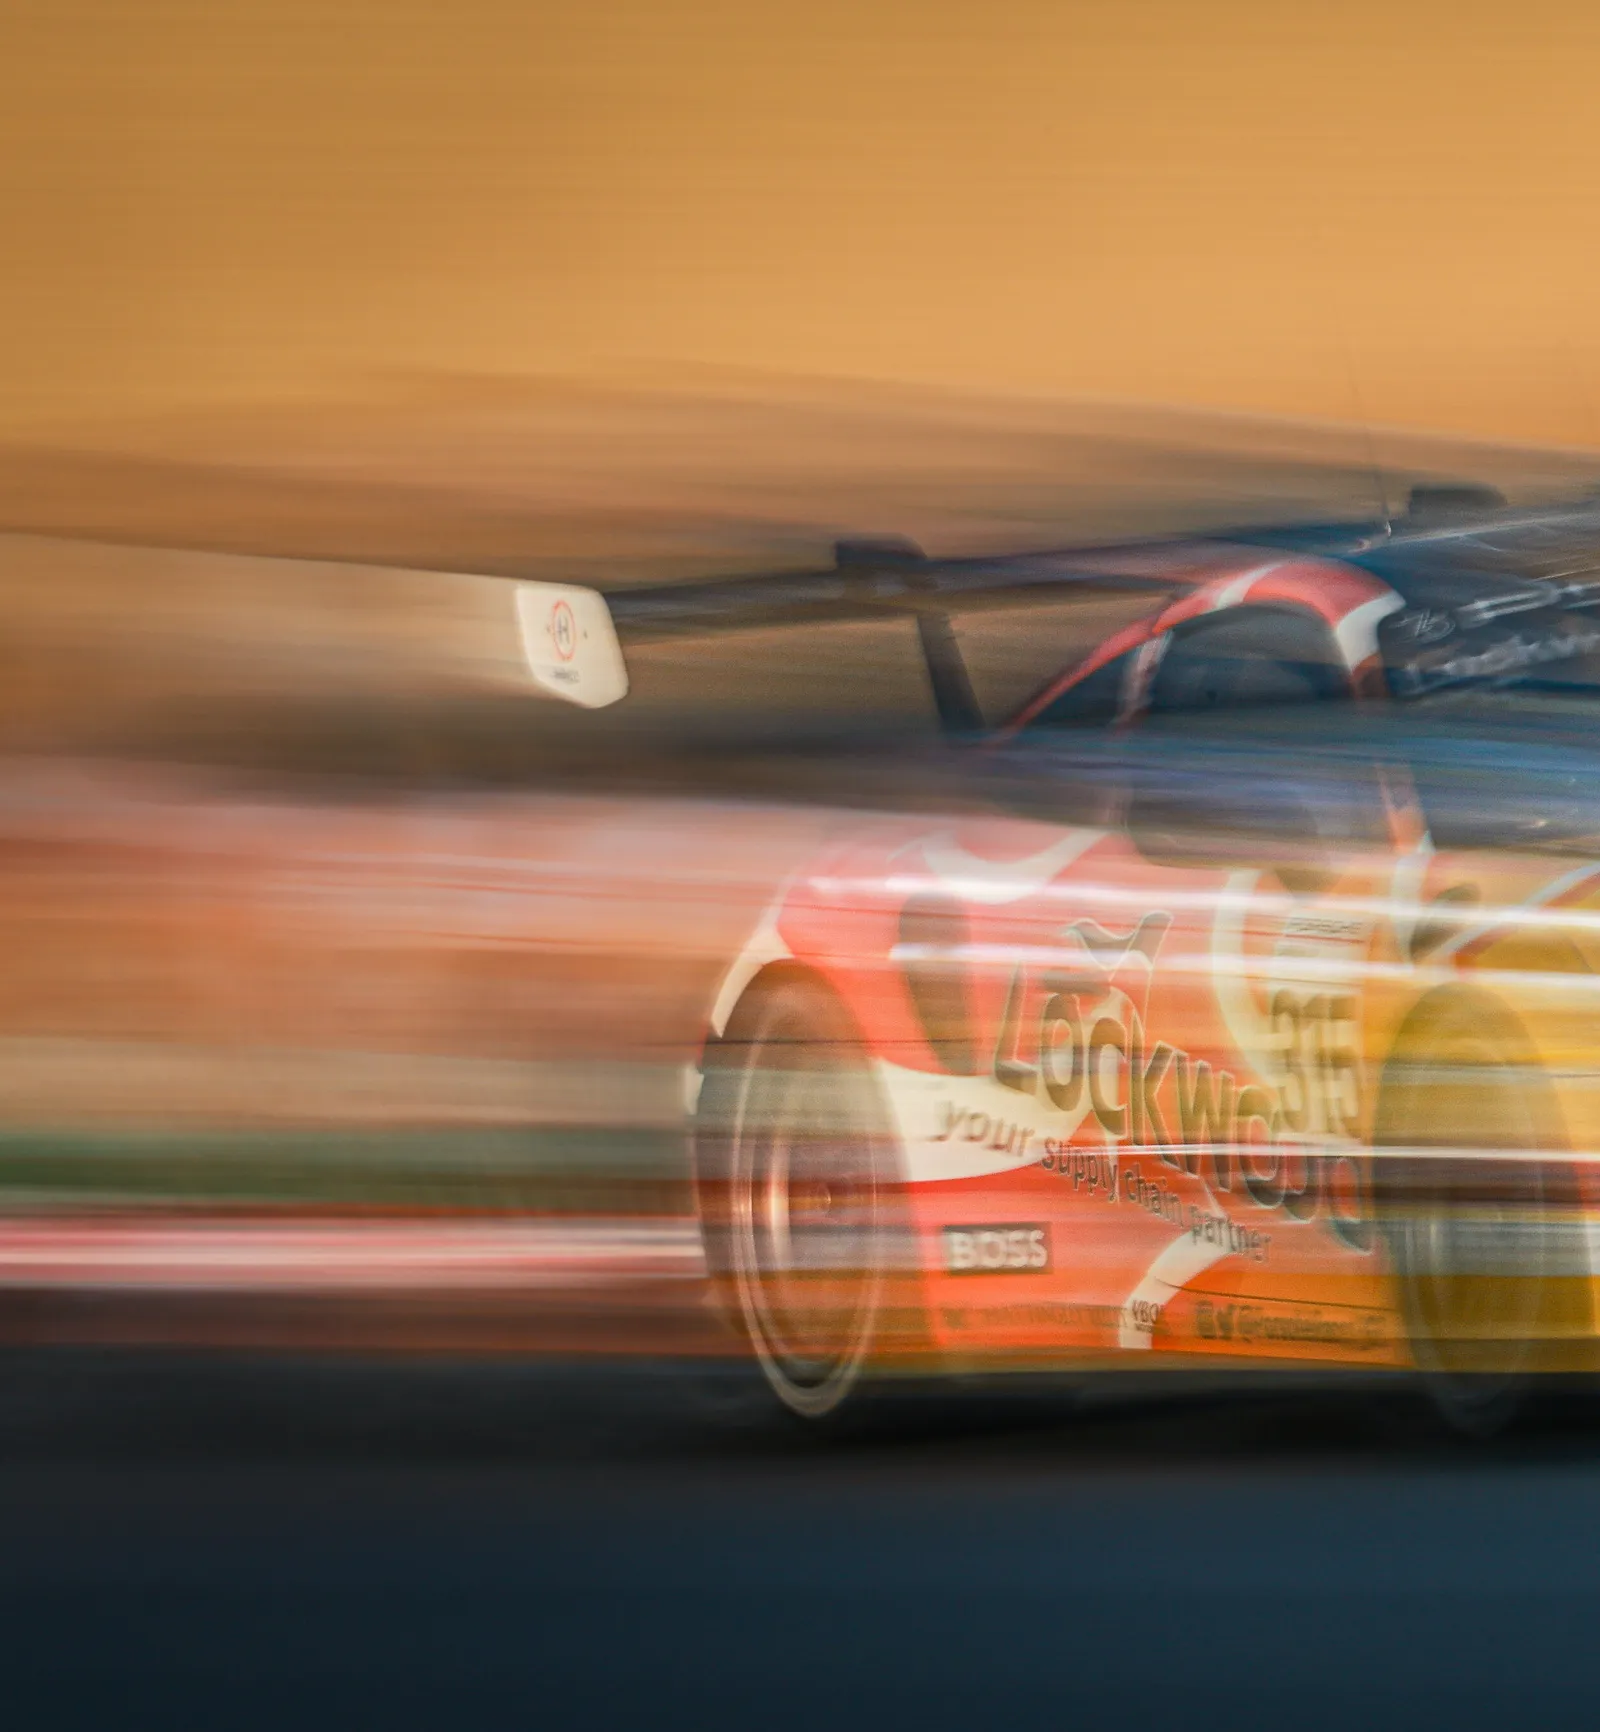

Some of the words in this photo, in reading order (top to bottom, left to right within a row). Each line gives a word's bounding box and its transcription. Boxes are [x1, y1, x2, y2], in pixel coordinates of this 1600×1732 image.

[1268, 988, 1362, 1142] 315
[931, 1097, 1036, 1158] your
[1041, 1137, 1122, 1203] supply
[1123, 1162, 1185, 1226] chain
[1189, 1204, 1273, 1264] partner
[945, 1227, 1049, 1270] BOSS
